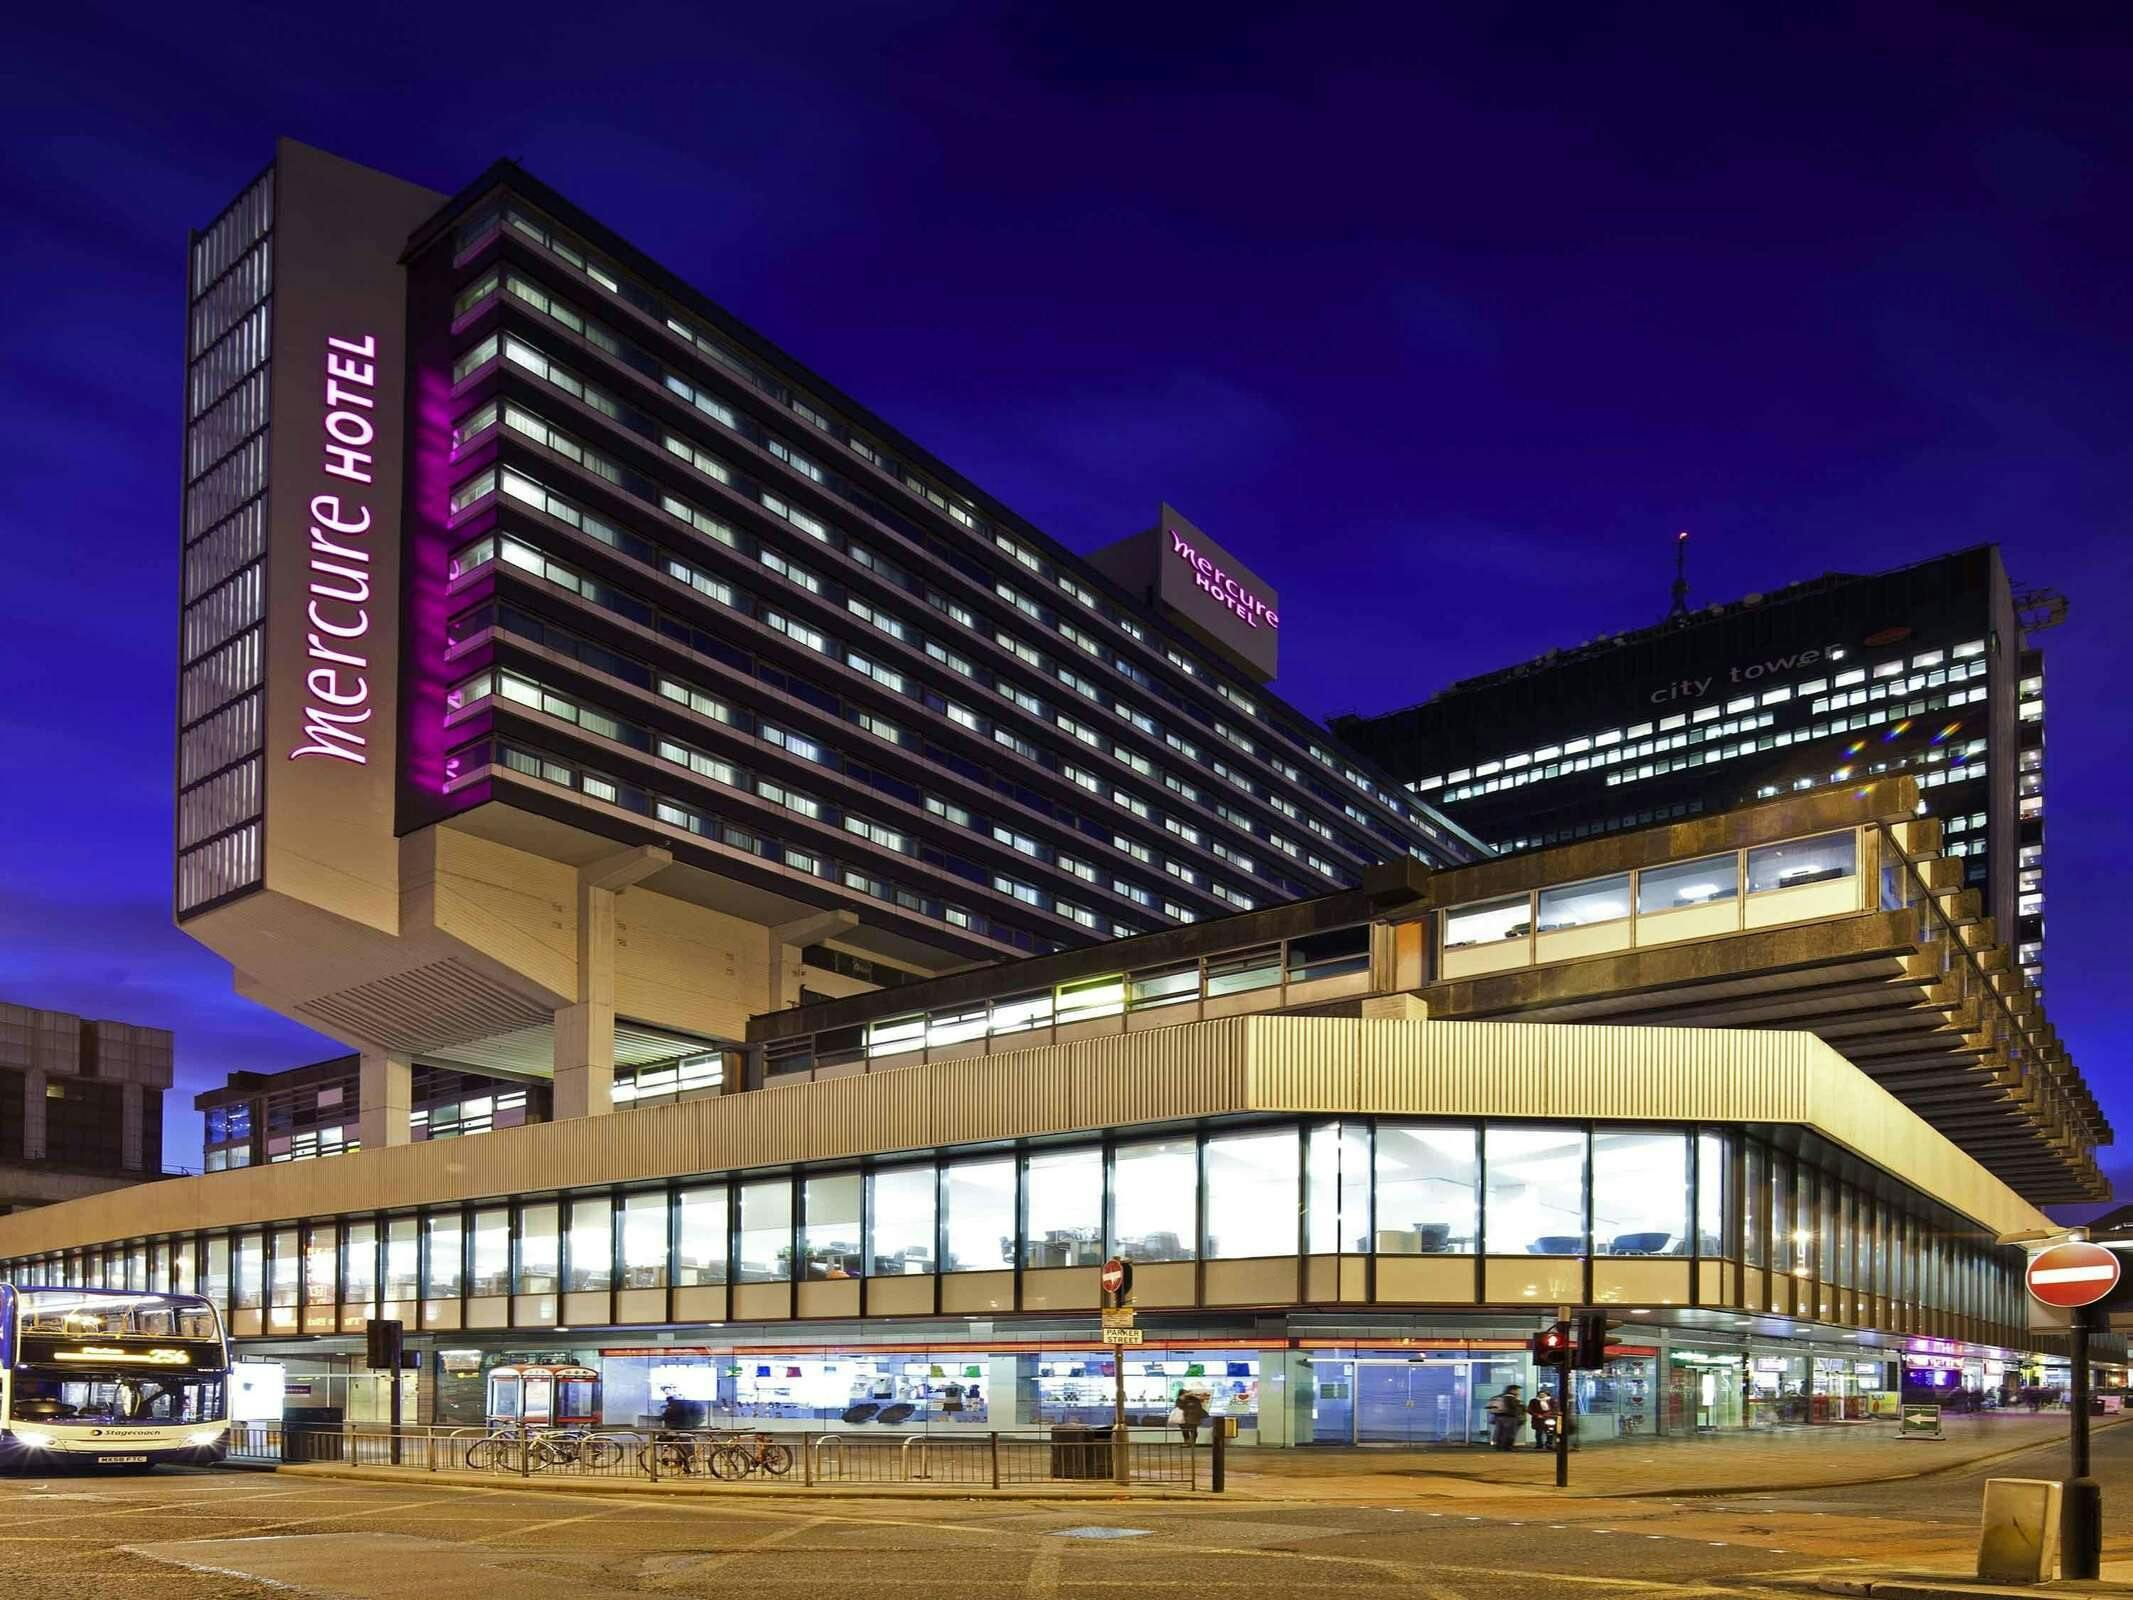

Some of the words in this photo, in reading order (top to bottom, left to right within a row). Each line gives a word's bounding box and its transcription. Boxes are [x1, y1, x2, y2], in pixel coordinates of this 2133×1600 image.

[325, 335, 375, 483] HOTEL
[1196, 572, 1257, 628] HOTEL
[1651, 676, 1712, 704] city
[1730, 643, 1843, 683] tower
[1106, 1329, 1139, 1337] PARKER
[150, 1349, 190, 1364] 256
[105, 1429, 161, 1437] Stagecoach
